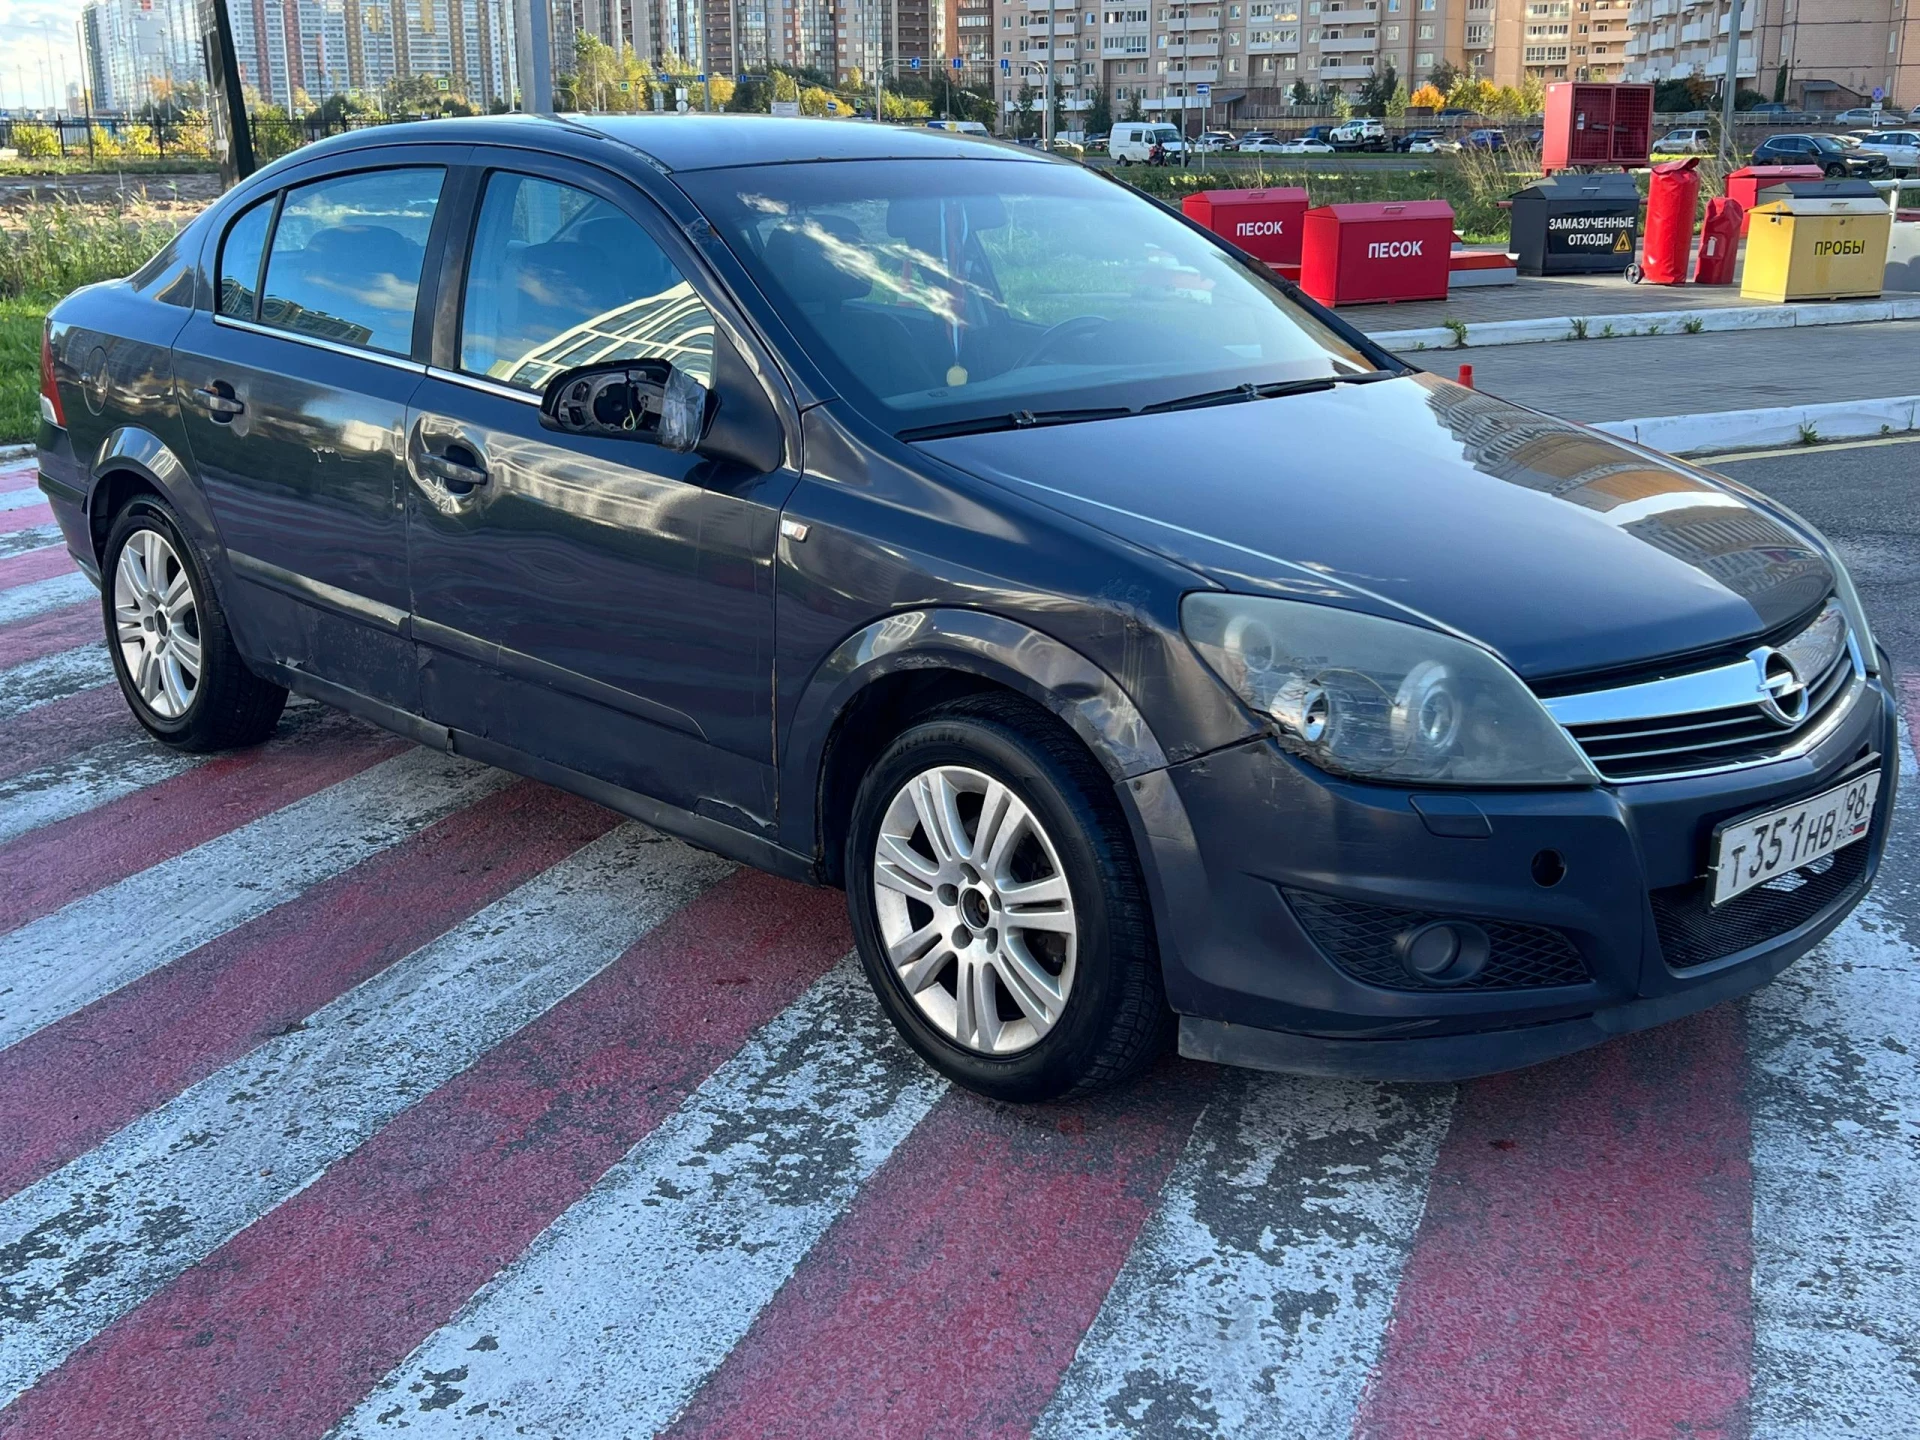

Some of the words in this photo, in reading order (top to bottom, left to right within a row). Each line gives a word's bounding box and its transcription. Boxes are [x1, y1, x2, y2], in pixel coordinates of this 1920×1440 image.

[1236, 221, 1283, 236] ПЕСОК
[1548, 217, 1634, 230] ЗАМАЗУЧЕННЫЕ
[1568, 233, 1613, 246] ОТХОДЫ
[1368, 240, 1423, 258] ПЕСОК
[1814, 240, 1865, 255] ПРОБЫ
